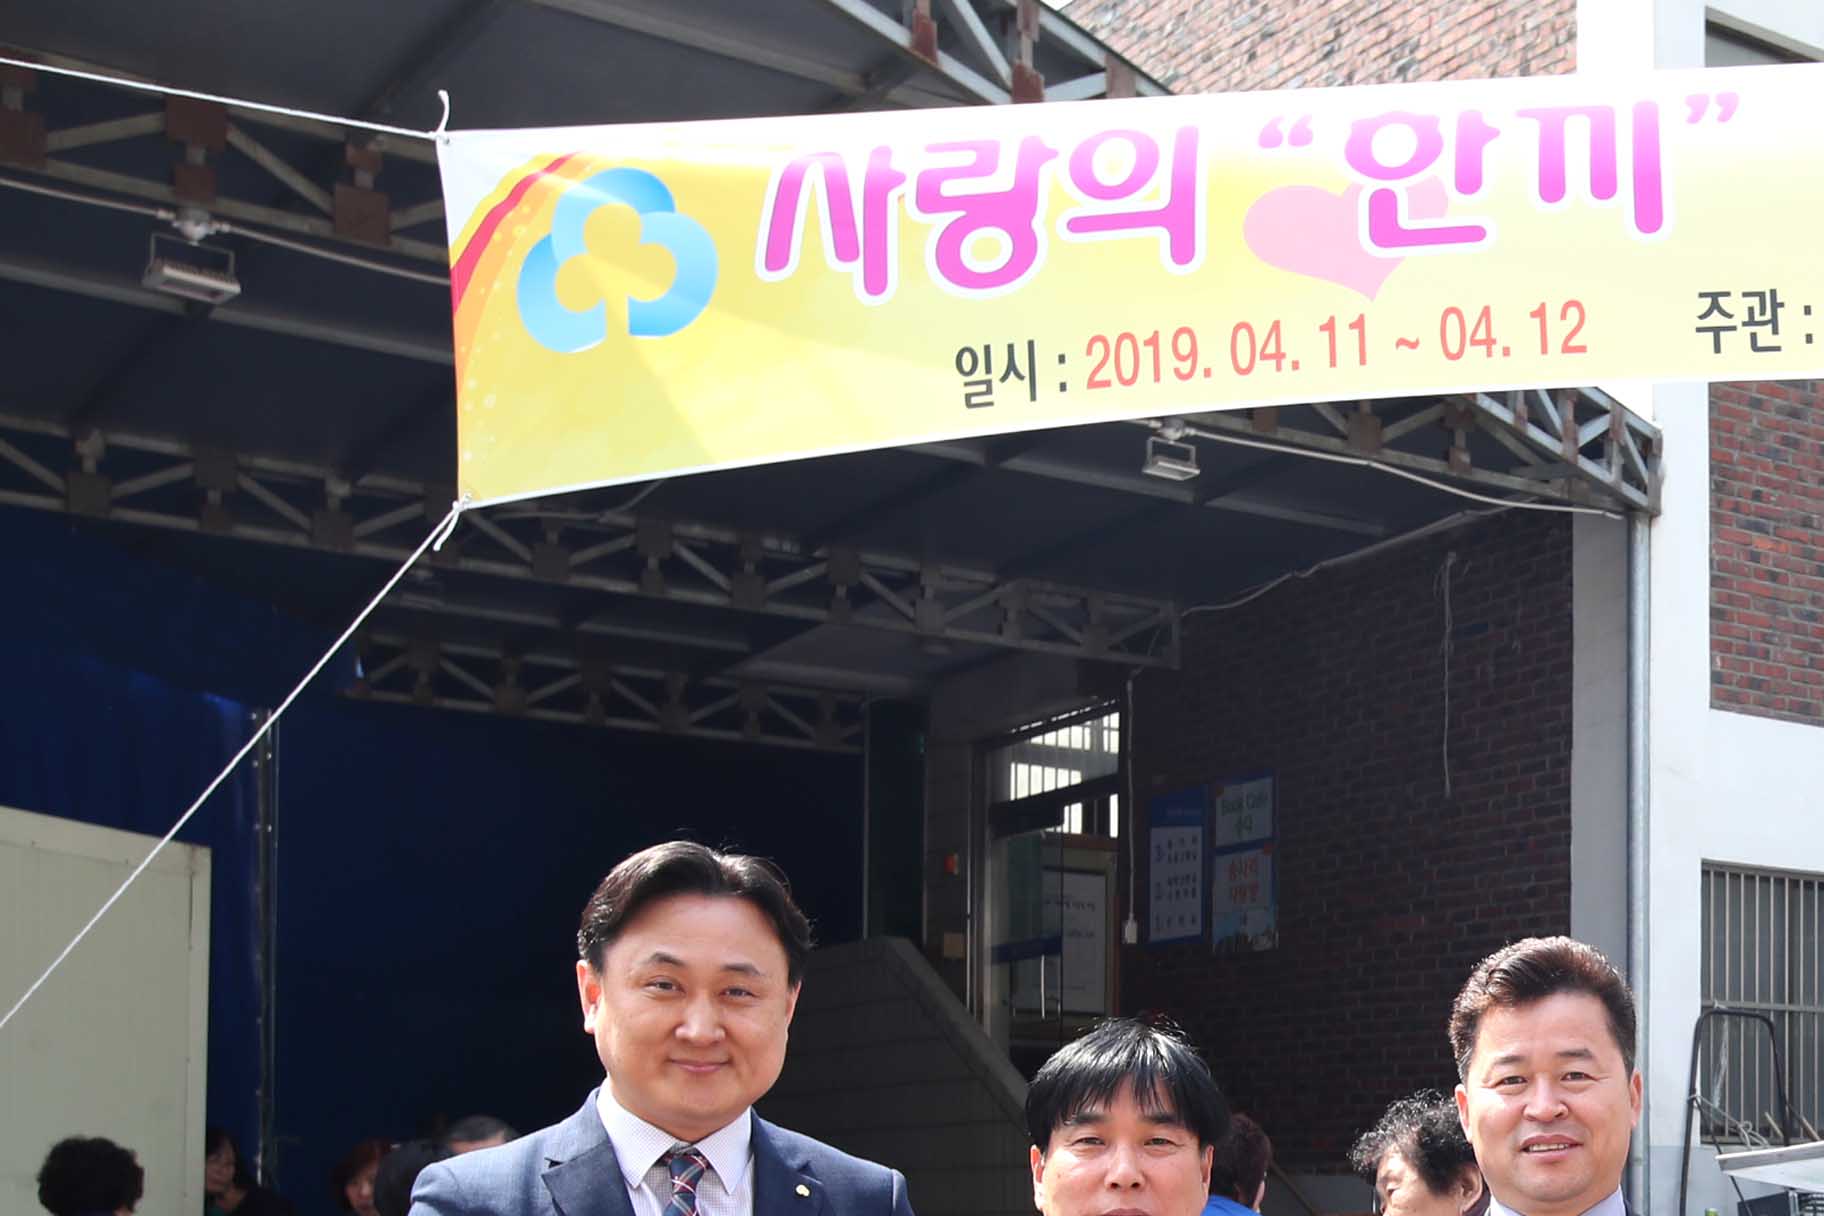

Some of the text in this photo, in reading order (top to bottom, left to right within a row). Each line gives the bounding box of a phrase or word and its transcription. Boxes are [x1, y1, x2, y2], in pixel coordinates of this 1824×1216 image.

[765, 126, 1198, 296] 사랑의
[1319, 313, 1367, 368] 11
[1529, 300, 1588, 355] 12
